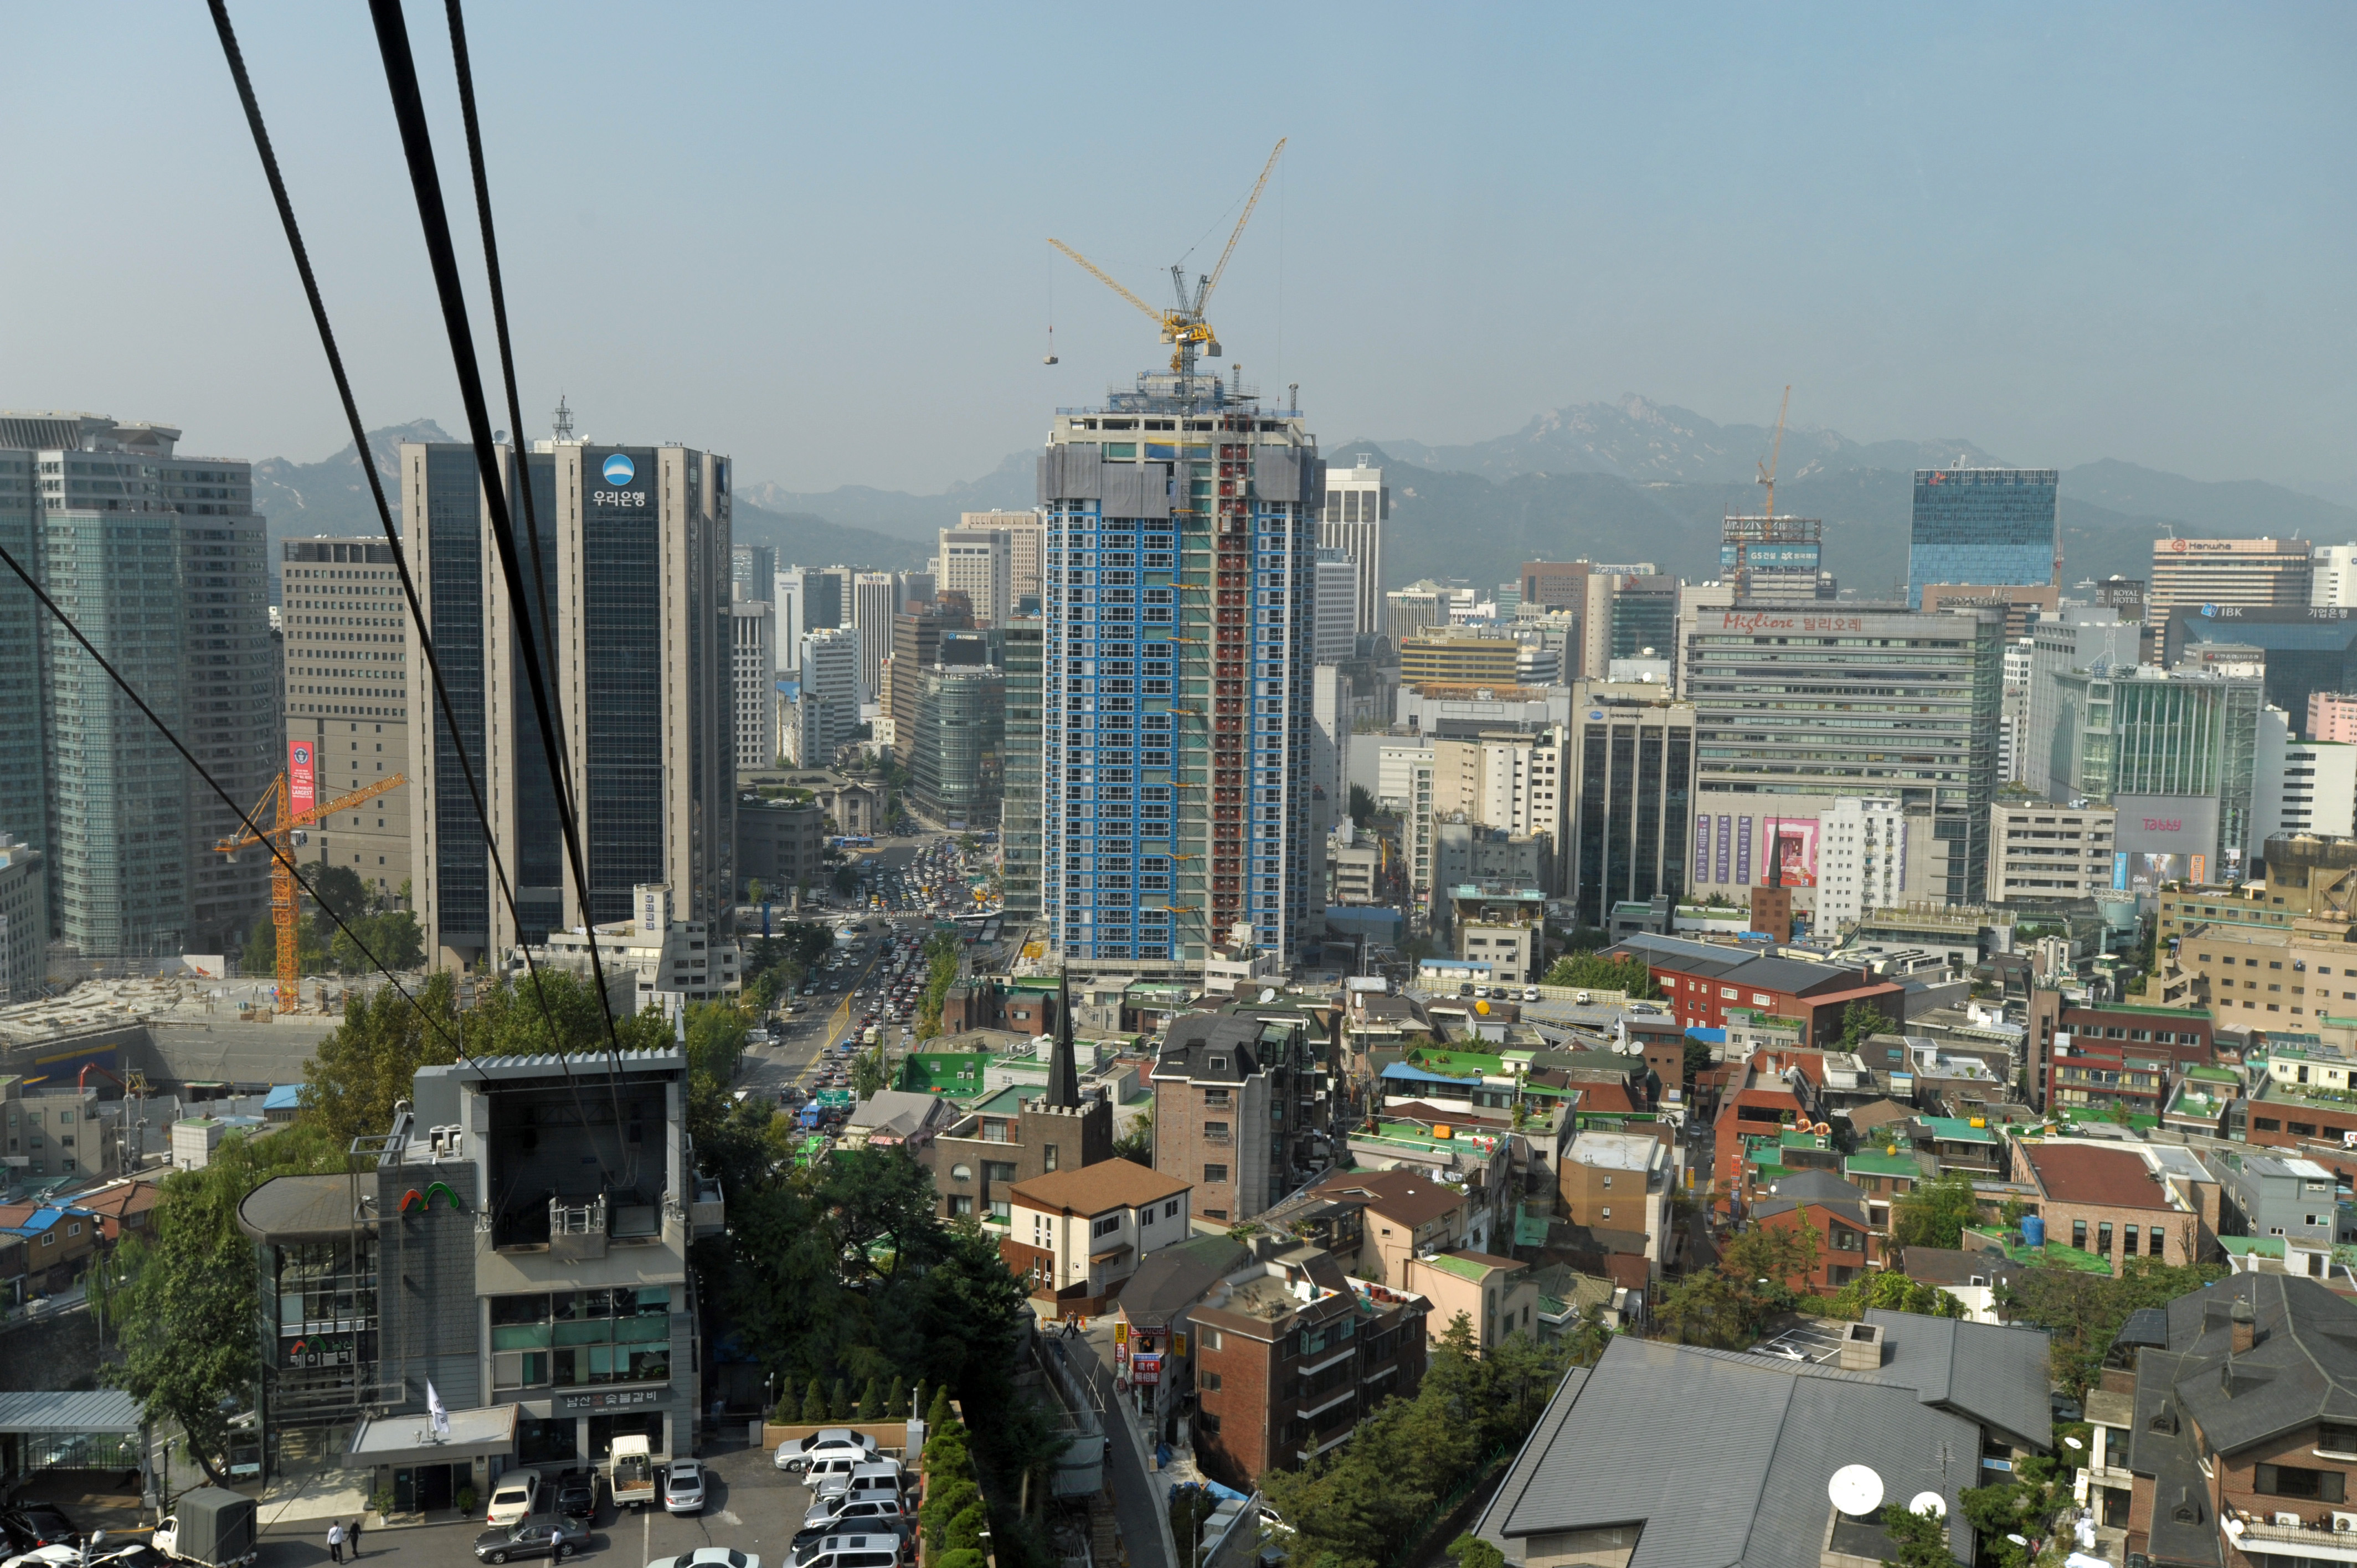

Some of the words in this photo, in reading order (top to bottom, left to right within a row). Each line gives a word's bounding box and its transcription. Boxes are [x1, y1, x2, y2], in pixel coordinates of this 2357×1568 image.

[593, 491, 645, 507] 우리은행
[2222, 608, 2242, 617] IBK
[2308, 608, 2348, 618] 기업은행
[1723, 612, 1794, 634] Migliore
[1804, 618, 1861, 632] 밀리오레
[332, 1340, 353, 1350] 남산
[290, 1351, 354, 1368] 케이블카
[1135, 1373, 1158, 1382] 照相館
